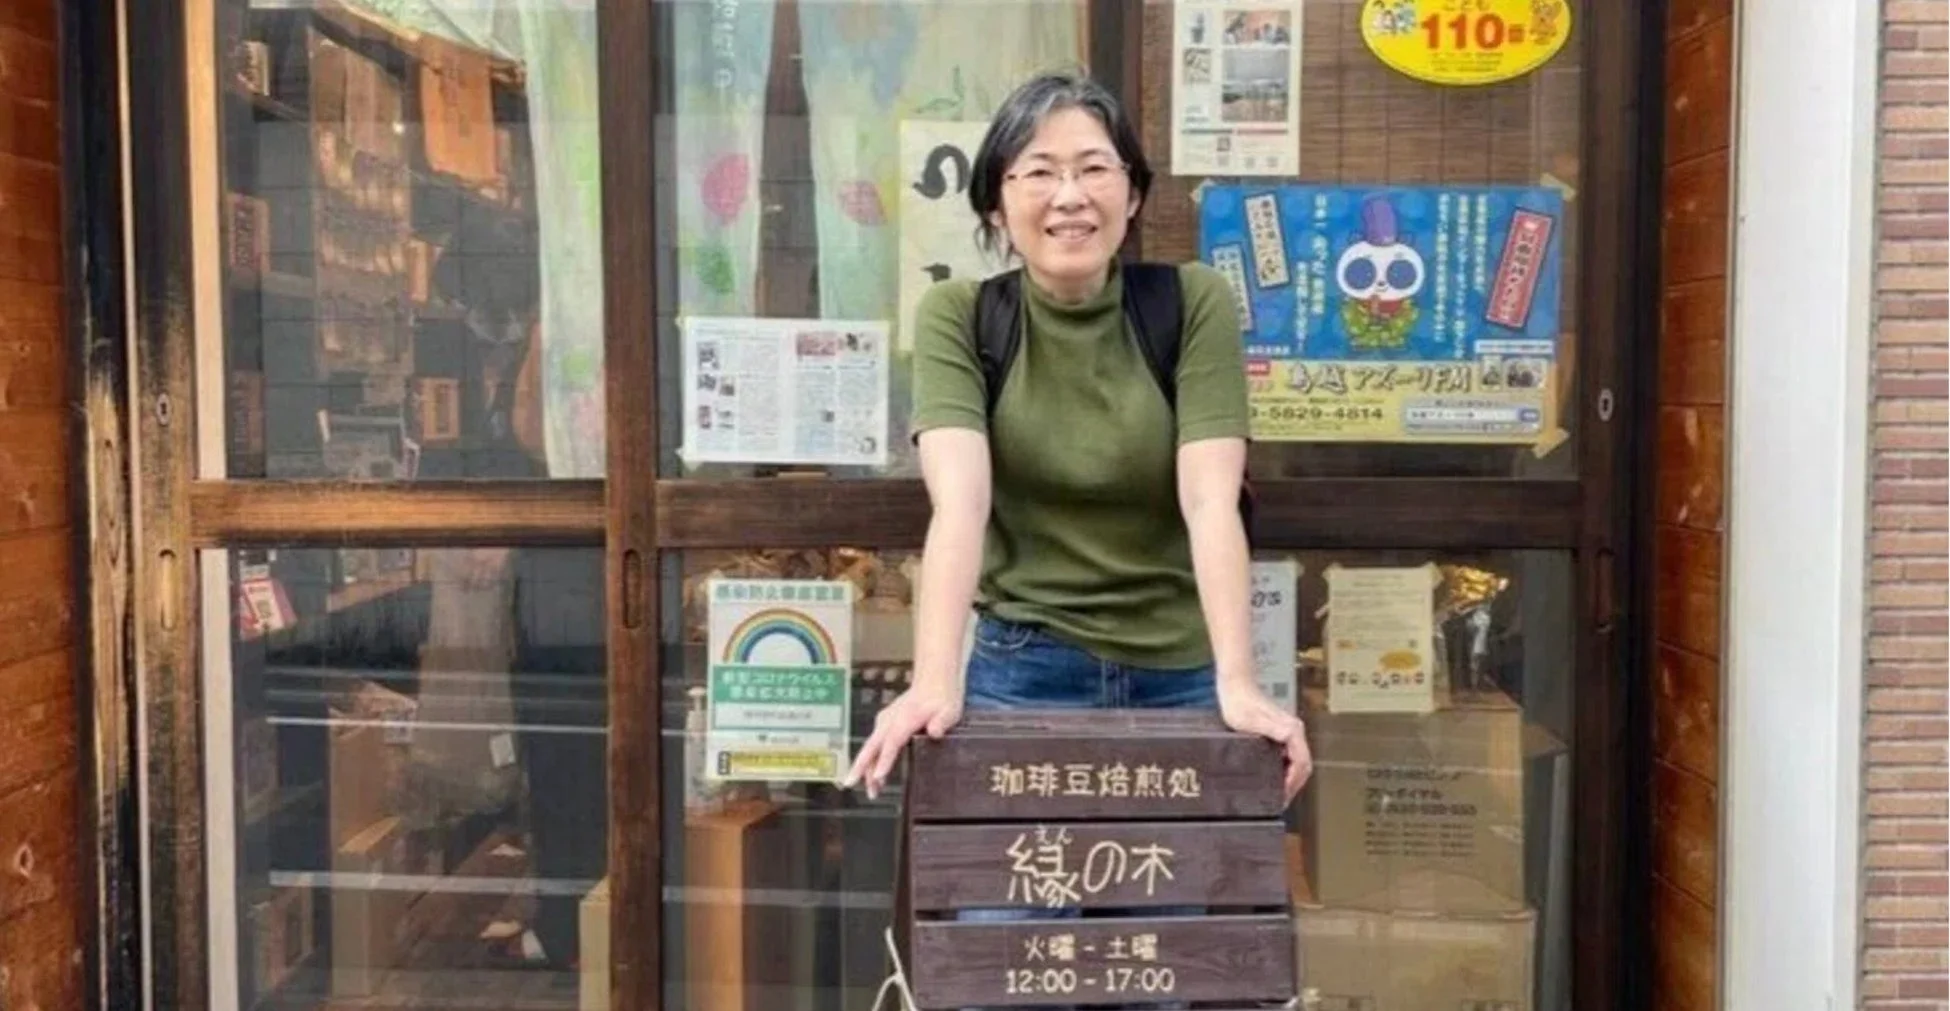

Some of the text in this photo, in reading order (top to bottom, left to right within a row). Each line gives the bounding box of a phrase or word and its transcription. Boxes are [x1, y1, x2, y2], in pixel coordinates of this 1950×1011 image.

[990, 762, 1200, 798] 珈琲豆焙煎処
[1006, 832, 1175, 908] 縁の木
[1025, 934, 1075, 961] 火曜
[1105, 933, 1158, 961] 土曜
[1006, 969, 1076, 994] 12:00
[1105, 967, 1175, 992] 17:00
